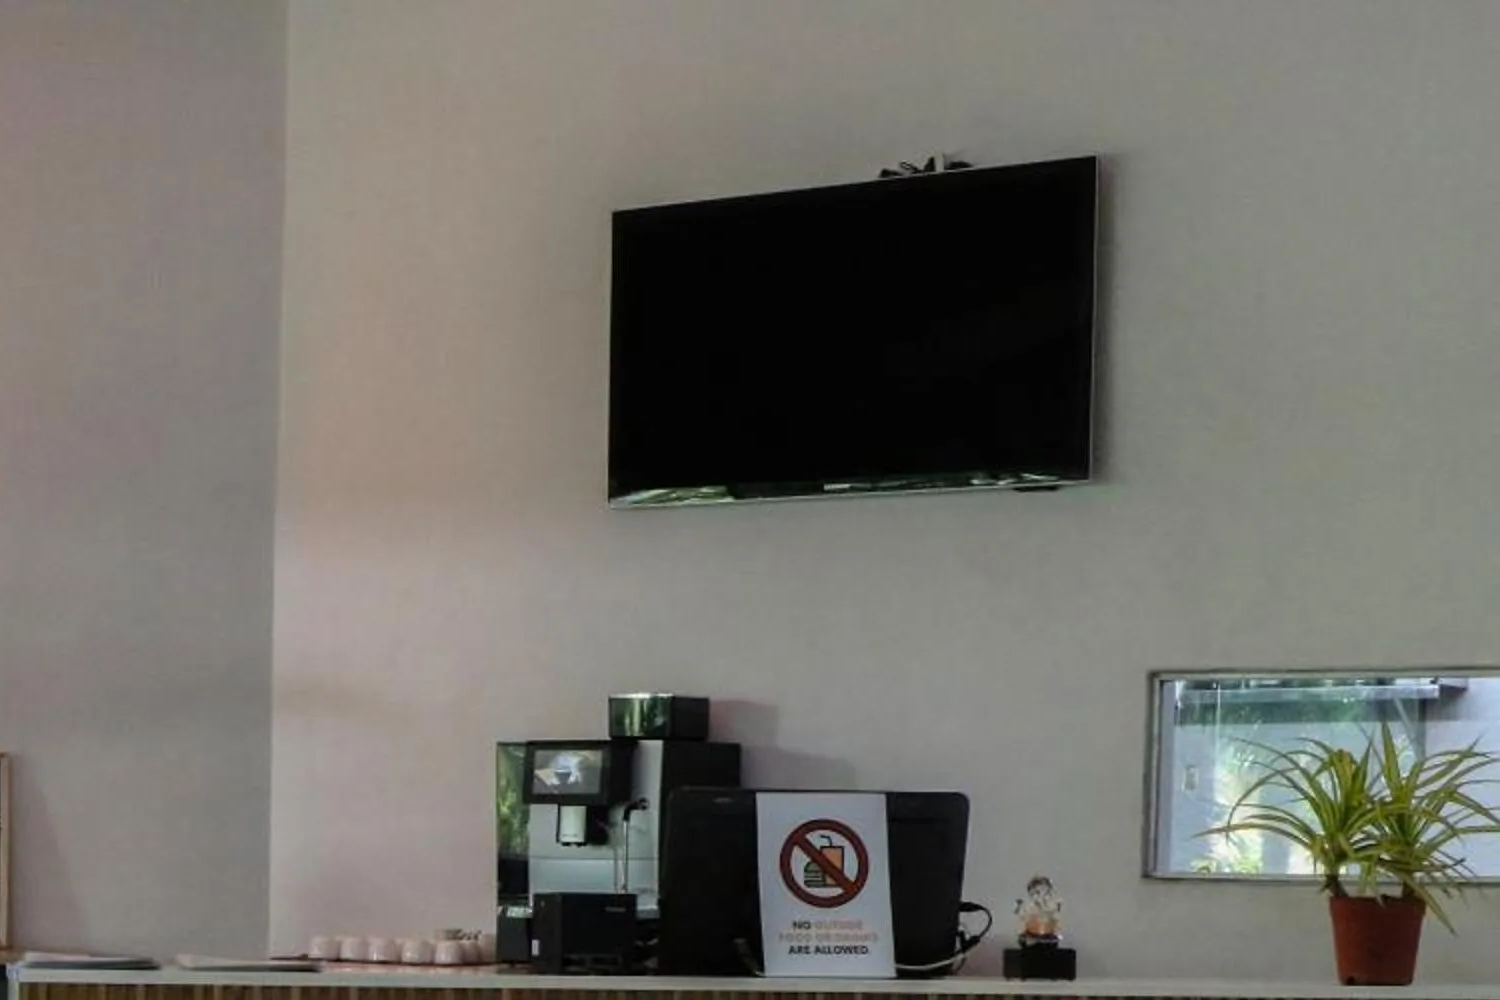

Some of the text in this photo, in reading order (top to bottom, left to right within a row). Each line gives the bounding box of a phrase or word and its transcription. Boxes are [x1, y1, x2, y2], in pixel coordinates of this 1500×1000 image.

[793, 920, 812, 930] NO
[788, 945, 869, 955] ARE ALLOWED
